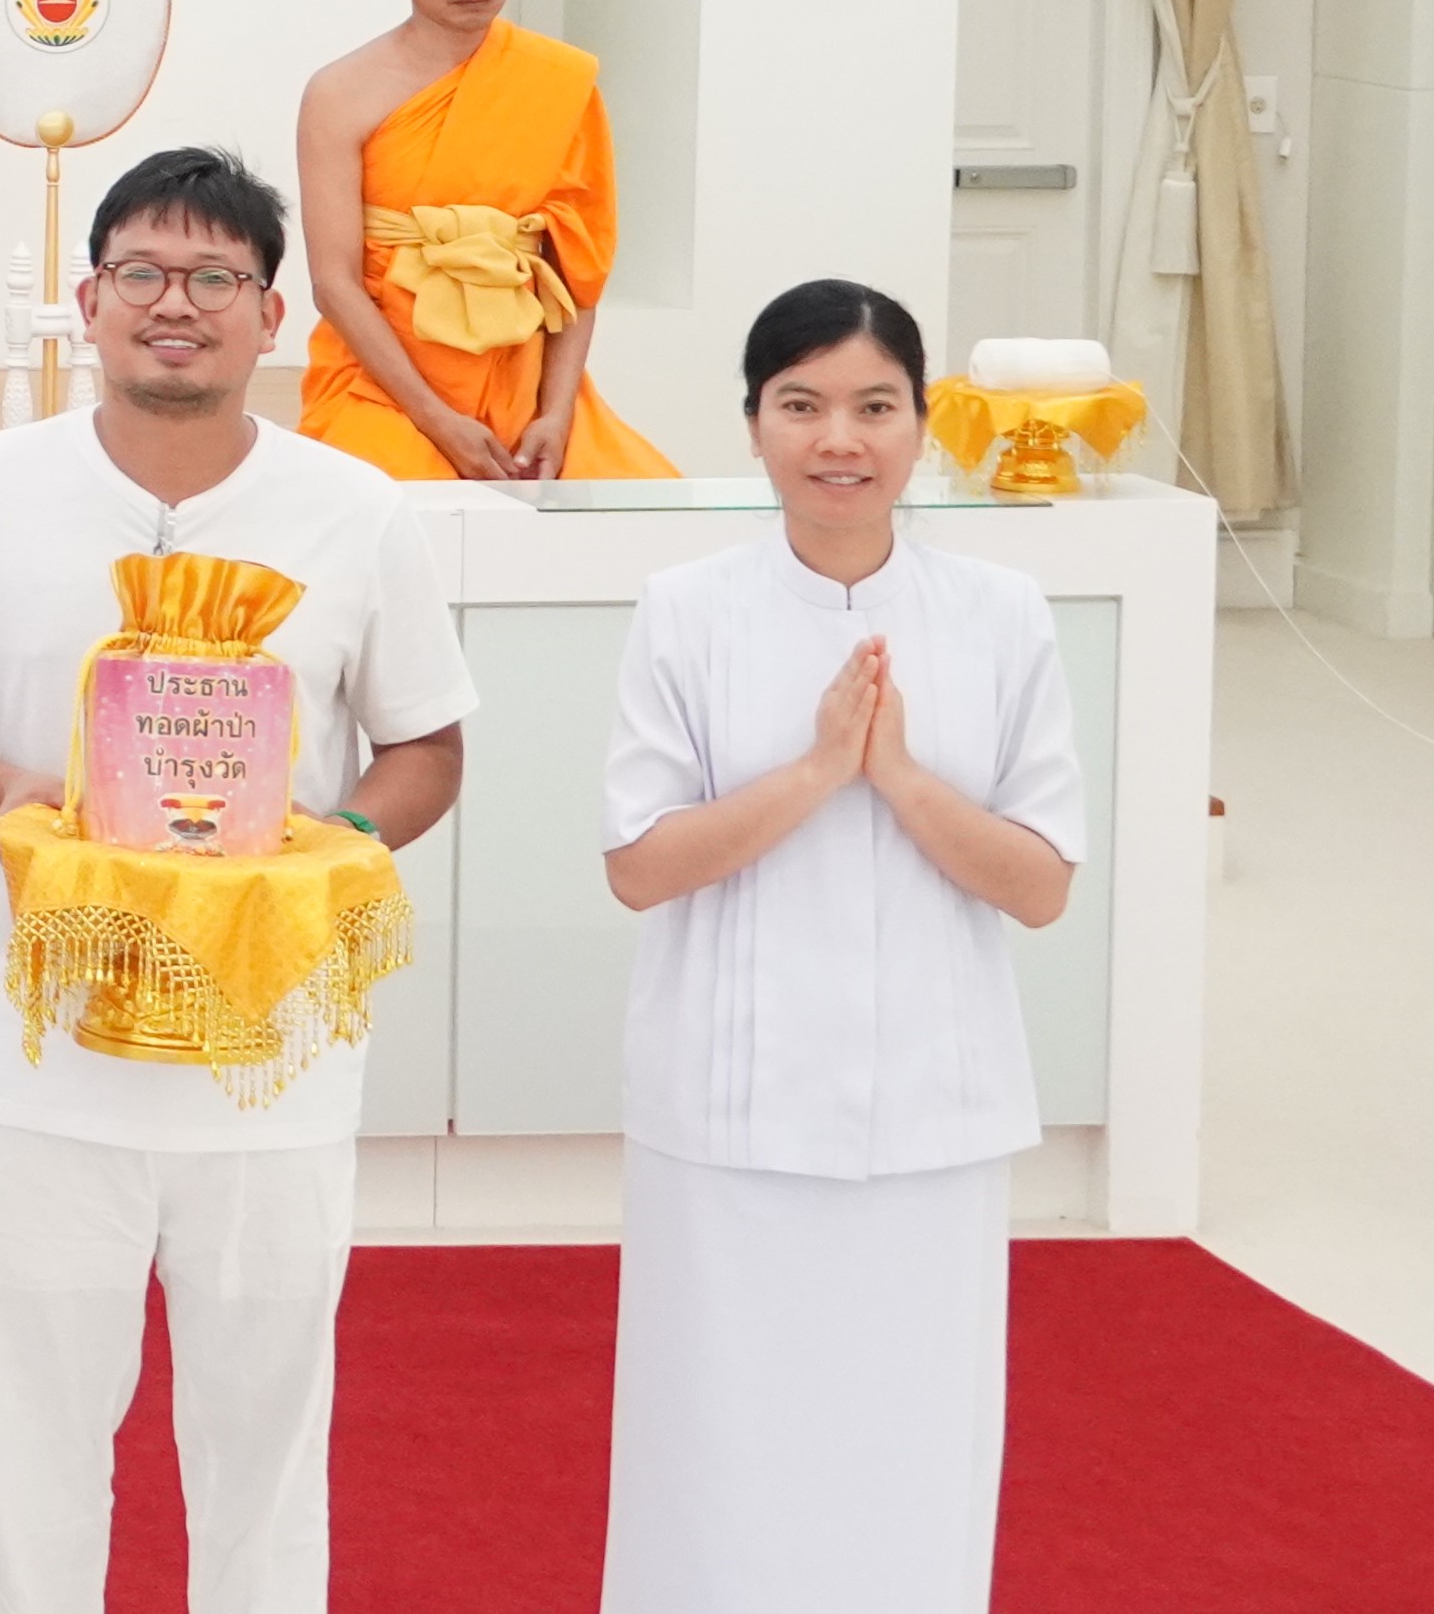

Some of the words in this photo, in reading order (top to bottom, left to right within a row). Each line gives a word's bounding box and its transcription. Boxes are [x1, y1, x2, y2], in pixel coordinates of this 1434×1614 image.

[147, 671, 249, 698] ประธาน
[135, 709, 256, 738] ทอดผ้าป่า
[143, 748, 247, 789] บำรุงวัด
